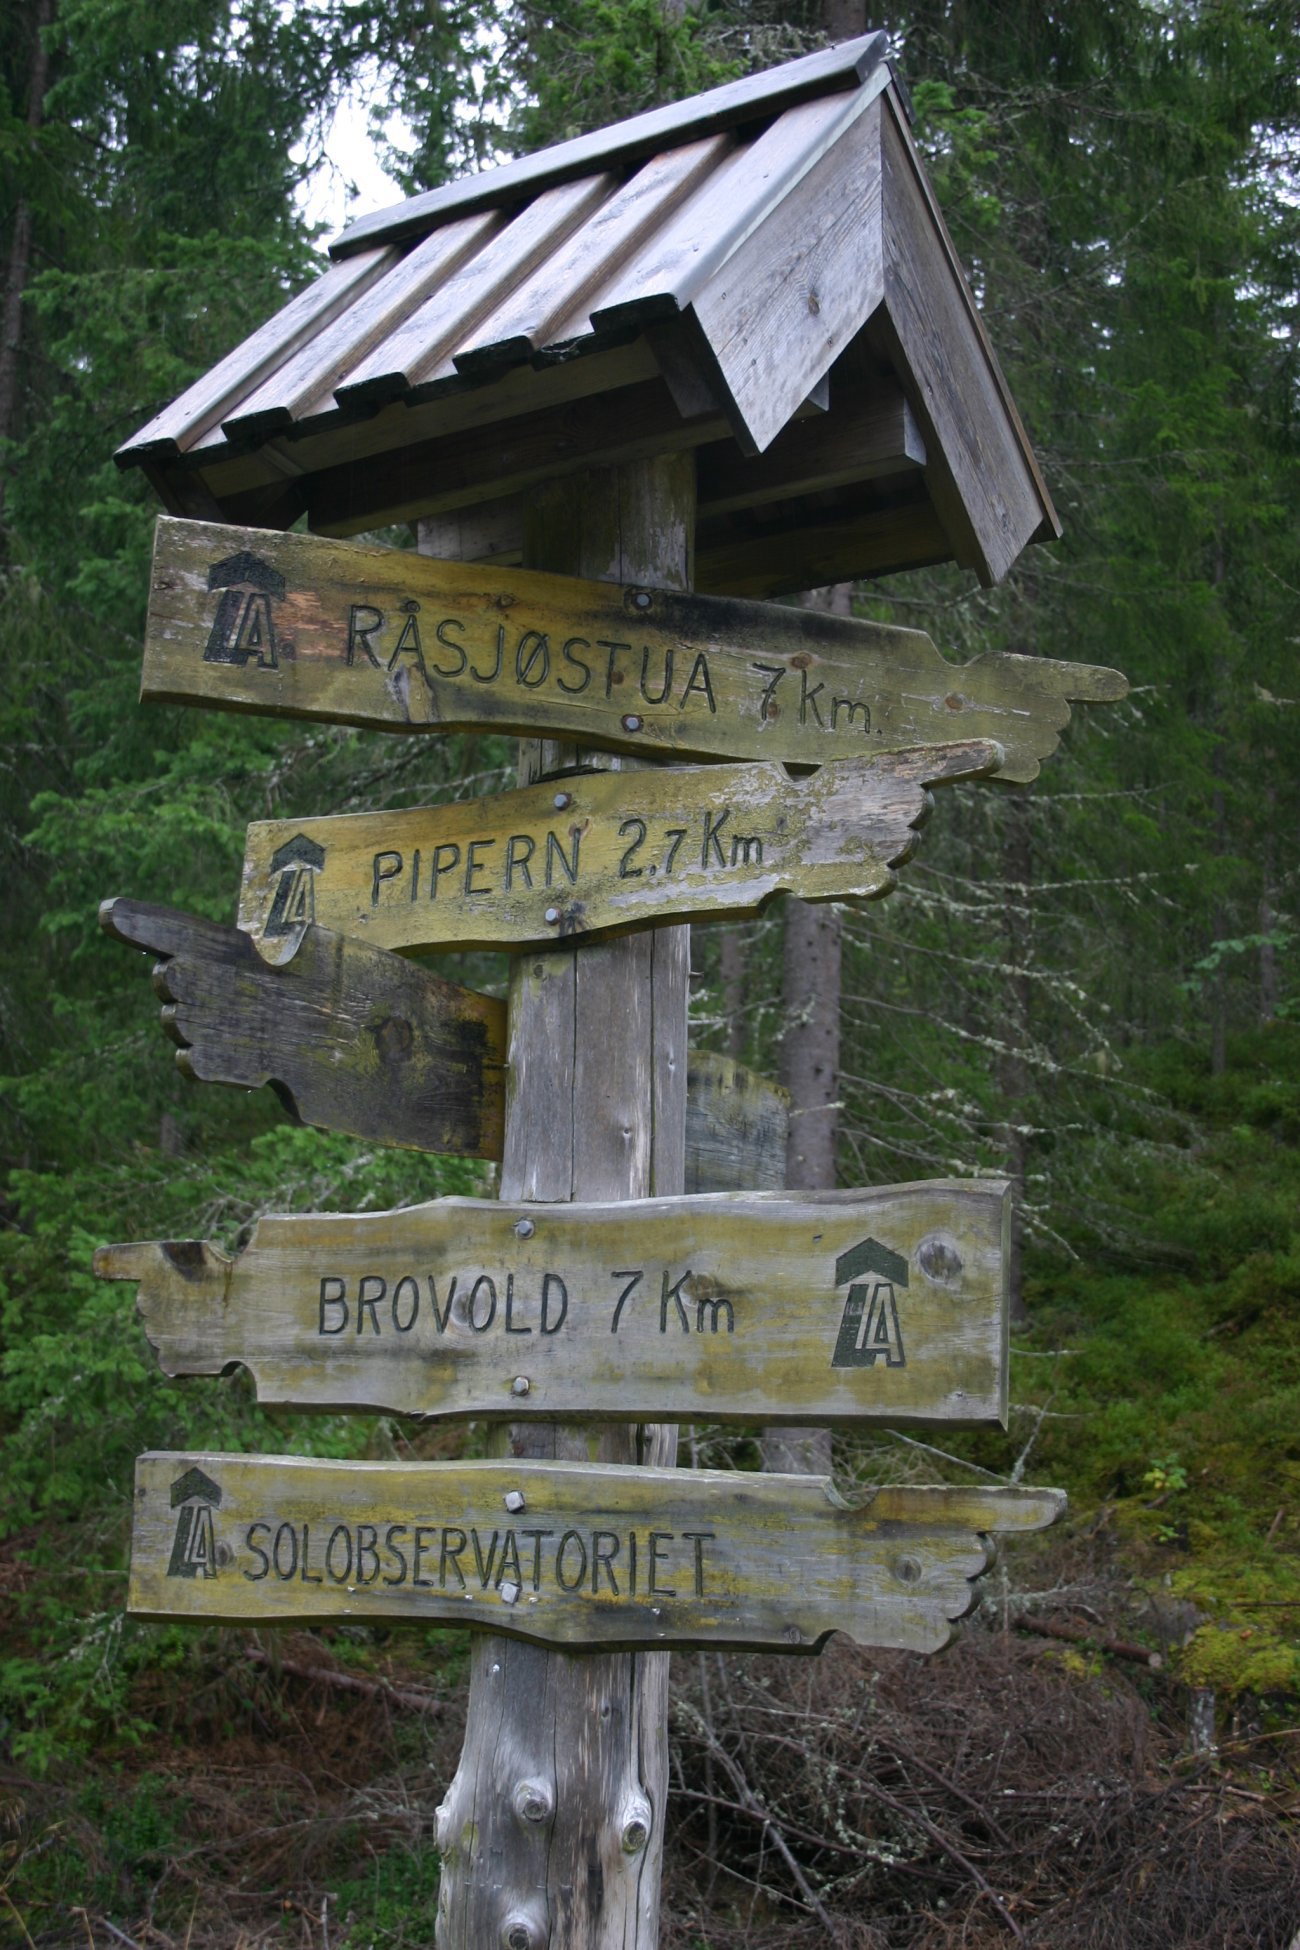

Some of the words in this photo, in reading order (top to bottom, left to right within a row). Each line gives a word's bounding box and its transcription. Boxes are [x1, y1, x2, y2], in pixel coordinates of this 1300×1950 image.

[346, 600, 716, 714] RÅSJØSTUA
[752, 662, 787, 721] 7
[372, 826, 581, 906] PIPERN
[701, 808, 764, 869] Km
[318, 1272, 570, 1337] BROVOLD
[610, 1270, 645, 1334] 7
[661, 1270, 736, 1335] Km
[244, 1521, 717, 1597] SOLOBSERVATORIET
